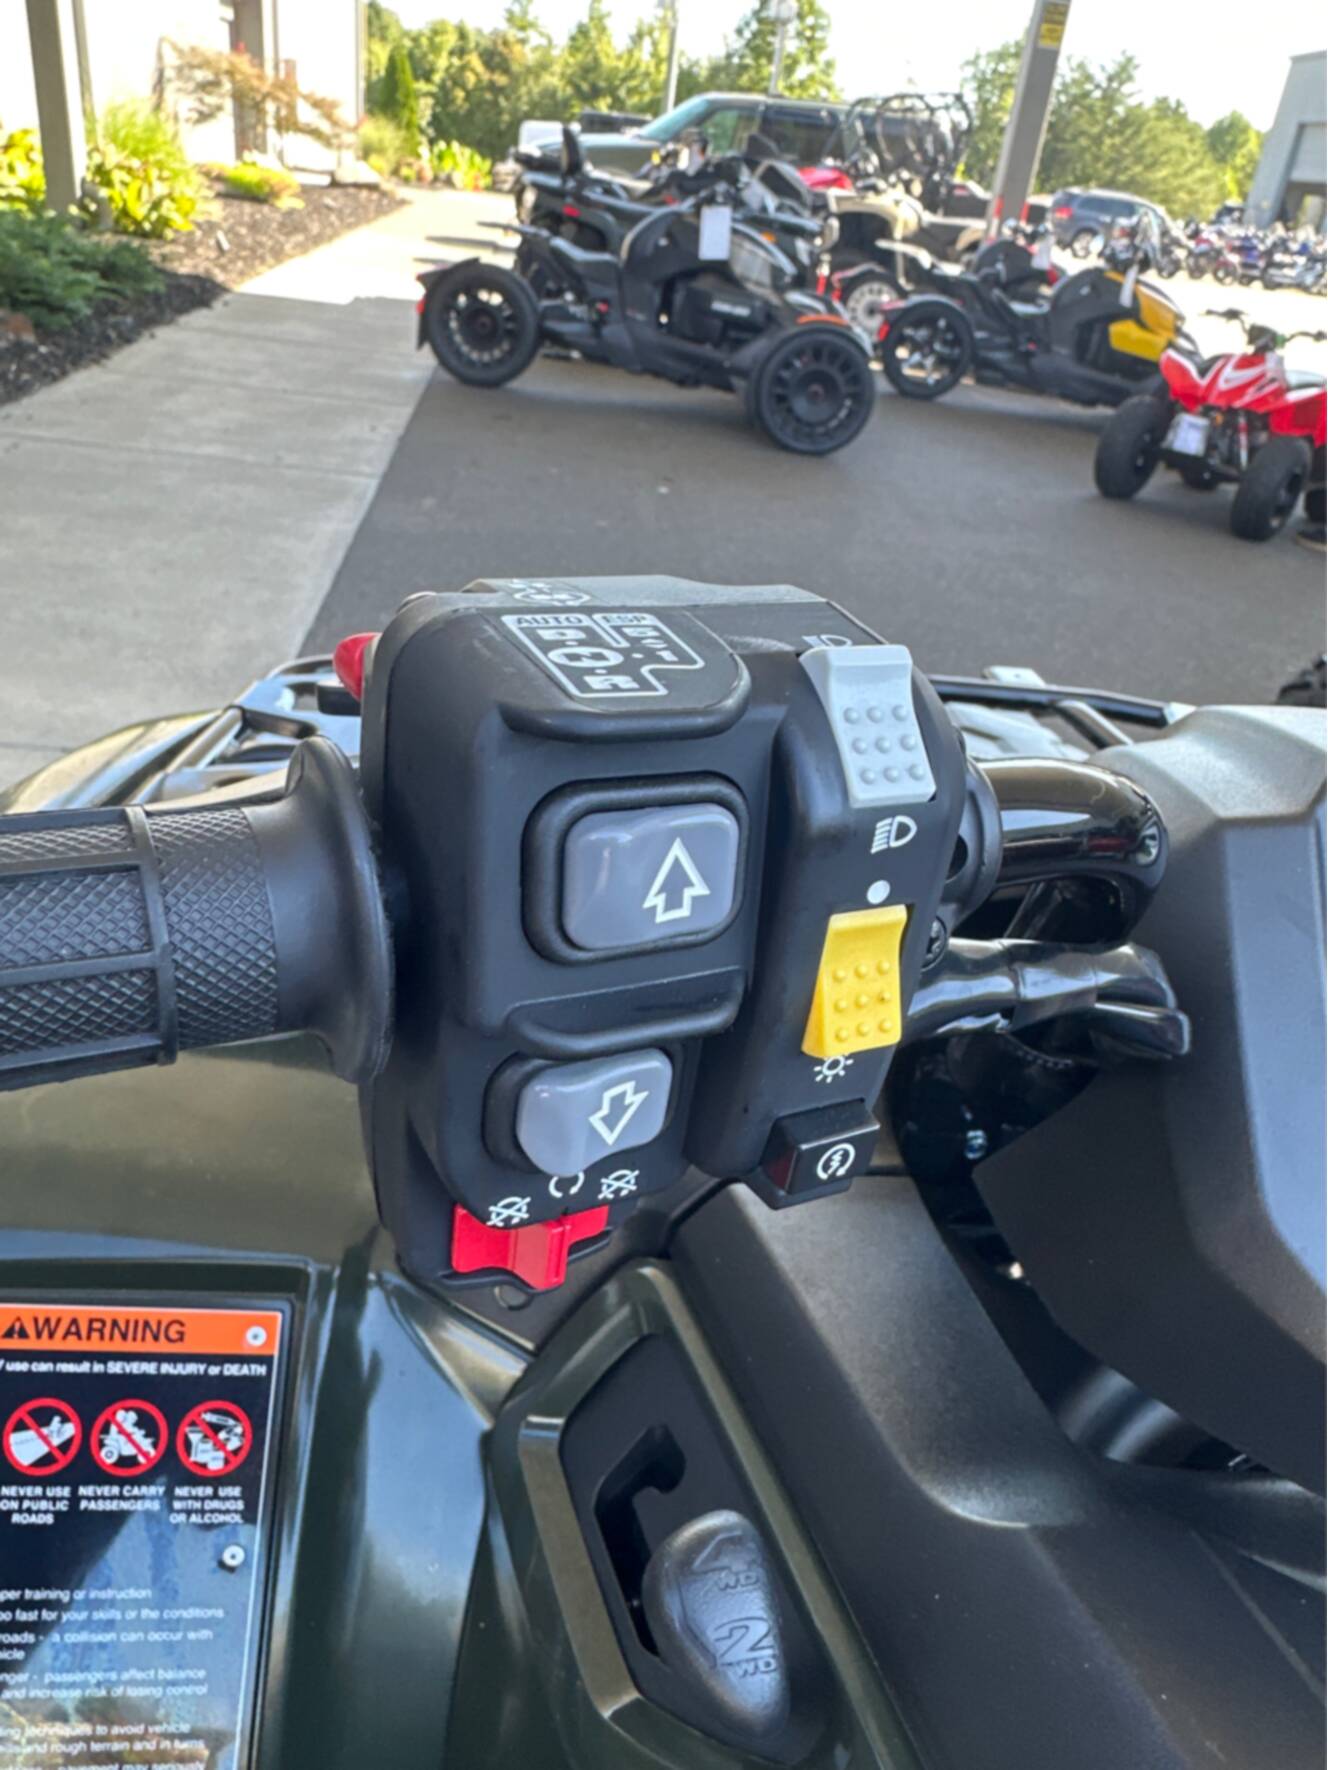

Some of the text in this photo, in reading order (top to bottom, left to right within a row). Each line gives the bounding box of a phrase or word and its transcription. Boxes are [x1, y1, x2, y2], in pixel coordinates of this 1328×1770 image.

[517, 616, 583, 626] AUTO
[583, 675, 640, 690] R
[33, 1316, 186, 1343] WARNING
[5, 1361, 29, 1373] use
[31, 1361, 54, 1373] can
[56, 1360, 90, 1374] result
[92, 1360, 105, 1374] in
[106, 1360, 158, 1375] SEVERE
[160, 1361, 207, 1376] INJURY
[207, 1364, 221, 1376] or
[222, 1363, 267, 1376] DEATH
[1, 1485, 71, 1497] NEVER USE
[78, 1485, 165, 1497] NEVER CARRY
[174, 1486, 242, 1497] NEVER USE
[0, 1500, 69, 1511] ON PUBLIC
[79, 1499, 160, 1511] PASSENGERS
[173, 1500, 244, 1511] WITH DRUGS
[11, 1513, 54, 1525] ROADS
[169, 1513, 244, 1524] OR ALCOHOL
[24, 1587, 70, 1603] training
[73, 1590, 87, 1600] or
[88, 1587, 152, 1600] instruction
[15, 1608, 39, 1621] fast
[41, 1608, 58, 1621] for
[61, 1610, 89, 1624] your
[124, 1610, 138, 1620] or
[141, 1607, 160, 1620] the
[162, 1606, 225, 1619] conditions
[119, 1631, 144, 1642] can
[146, 1630, 184, 1642] occur
[186, 1628, 214, 1641] with
[44, 1670, 117, 1685] passengers
[121, 1667, 155, 1681] affect
[157, 1667, 206, 1680] balance
[110, 1685, 125, 1698] of
[165, 1682, 208, 1696] control
[95, 1724, 108, 1735] to
[110, 1723, 145, 1735] avoid
[147, 1722, 191, 1734] vehicle
[50, 1742, 87, 1756] rough
[132, 1740, 157, 1752] and
